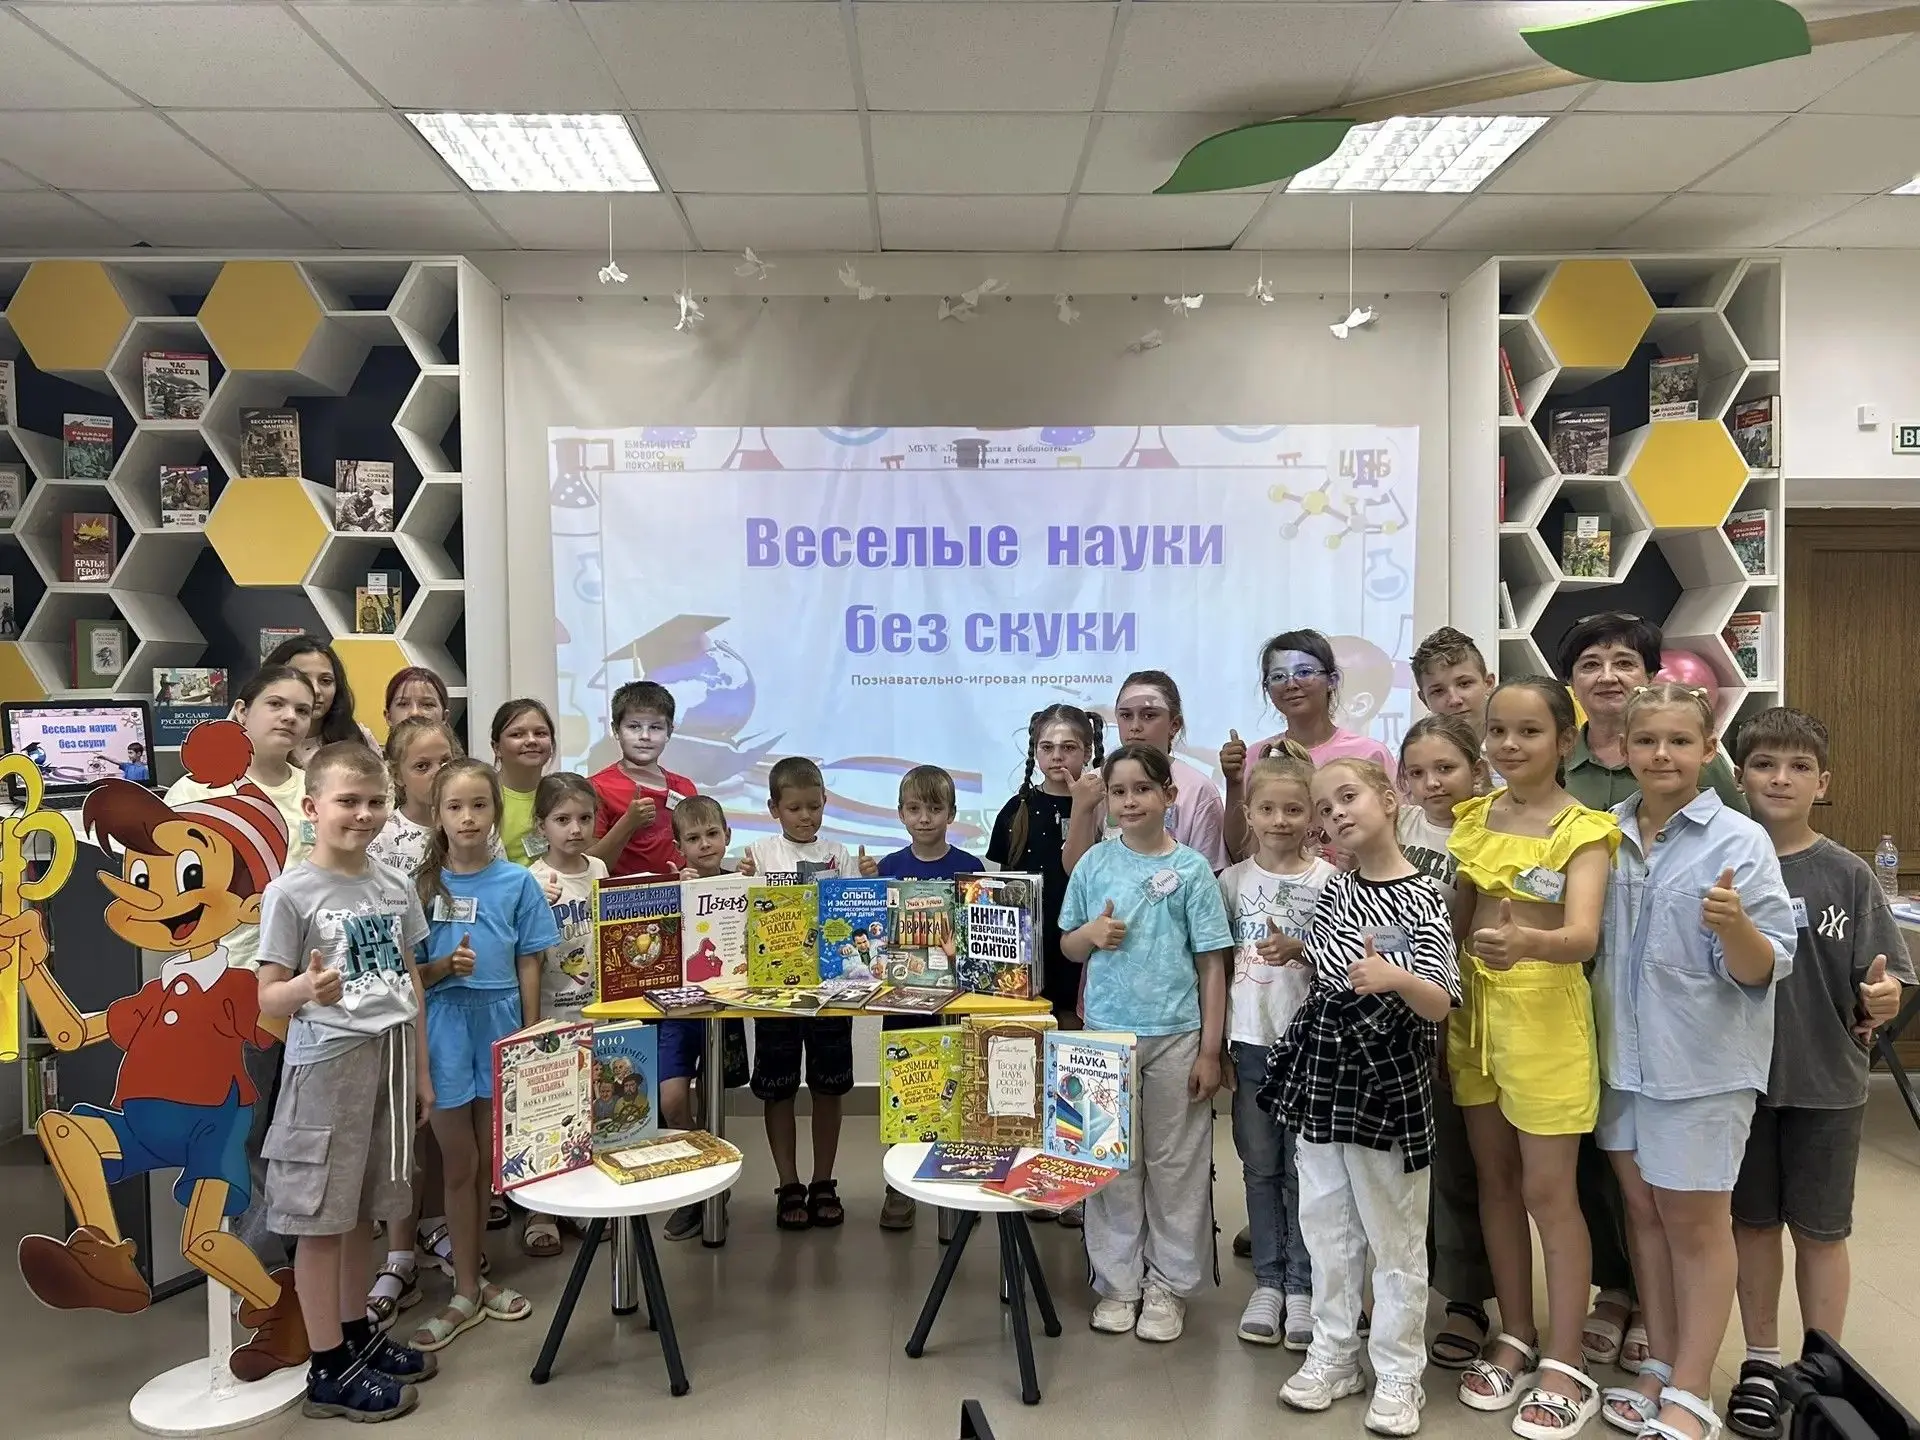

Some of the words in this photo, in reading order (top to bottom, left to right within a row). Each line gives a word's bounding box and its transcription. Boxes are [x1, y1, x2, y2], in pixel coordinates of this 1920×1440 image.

[155, 367, 200, 376] МУЖЕСТВА
[169, 361, 186, 369] ЧАС
[1903, 429, 1920, 446] В
[624, 450, 665, 460] НОВОГО
[908, 444, 937, 452] МБУК
[624, 461, 685, 471] ПОКОЛЕНИЯ
[745, 517, 1019, 568] Веселые
[1047, 524, 1225, 572] науки
[845, 604, 949, 654] без
[964, 611, 1138, 660] скуки
[851, 673, 1027, 688] Познавательно-игровая
[1031, 675, 1113, 687] программа
[41, 724, 86, 734] Веселые
[89, 724, 117, 733] науки
[59, 740, 76, 749] без
[77, 739, 106, 748] скуки
[1534, 874, 1560, 889] София
[650, 888, 677, 900] КНИГА
[842, 891, 876, 899] ОПЫТЫ
[696, 894, 748, 916] Почему
[606, 903, 679, 922] МАЛЬЧИКОВ
[760, 911, 802, 927] БЕЗУМНАЯ
[971, 907, 1016, 926] КНИГА
[766, 921, 796, 935] НАУКА
[900, 920, 941, 934] ЭВРИКА
[971, 925, 1016, 936] НЕВЕРОЯТНЫХ
[971, 933, 1017, 945] НАУЧНЫХ
[971, 942, 1017, 959] ФАКТОВ
[575, 991, 594, 1000] DUCK
[597, 1035, 624, 1048] 100
[892, 1059, 940, 1077] БЕЗУМНАЯ
[996, 1059, 1026, 1072] Творцы
[1070, 1054, 1107, 1069] НАУКА
[900, 1071, 934, 1085] НАУКА
[1058, 1064, 1118, 1080] ЭНЦИКЛОПЕДИЯ
[936, 1143, 1014, 1152] УВЛЕКАТЕЛЬНЫЕ
[947, 1147, 998, 1156] ОПЫТЫ
[1035, 1156, 1110, 1177] УВЛЕКАТЕЛЬНЫЕ
[1040, 1162, 1090, 1179] ОПЫТЫ
